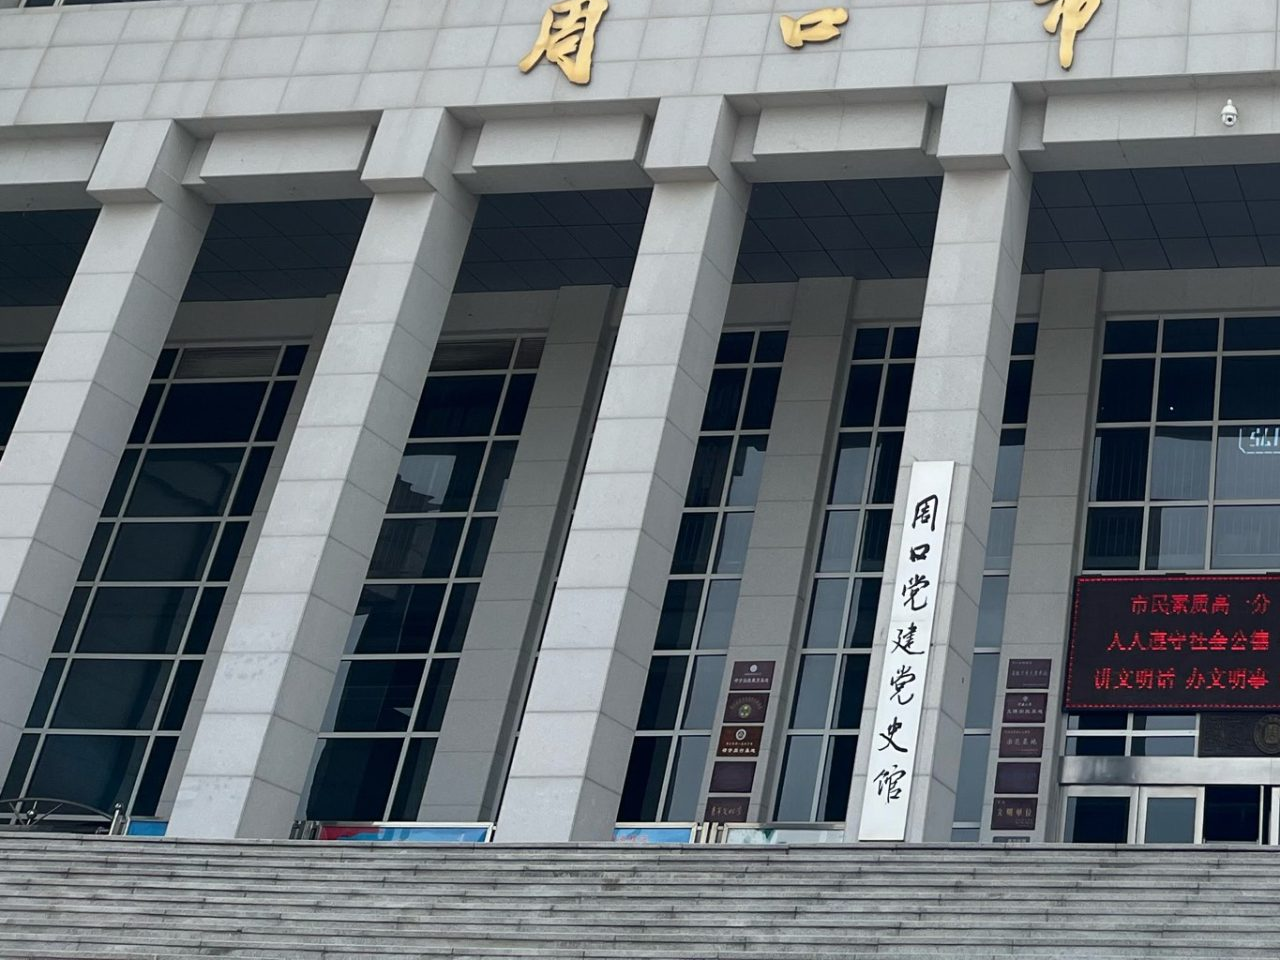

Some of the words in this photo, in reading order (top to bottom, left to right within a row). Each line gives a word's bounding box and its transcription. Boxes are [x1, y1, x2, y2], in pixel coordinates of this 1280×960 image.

[1131, 592, 1272, 616] 市民素质高分
[1106, 628, 1271, 652] 人人遵守社会公德
[1094, 666, 1177, 691] 讲文明话
[1185, 666, 1270, 691] 办文明事
